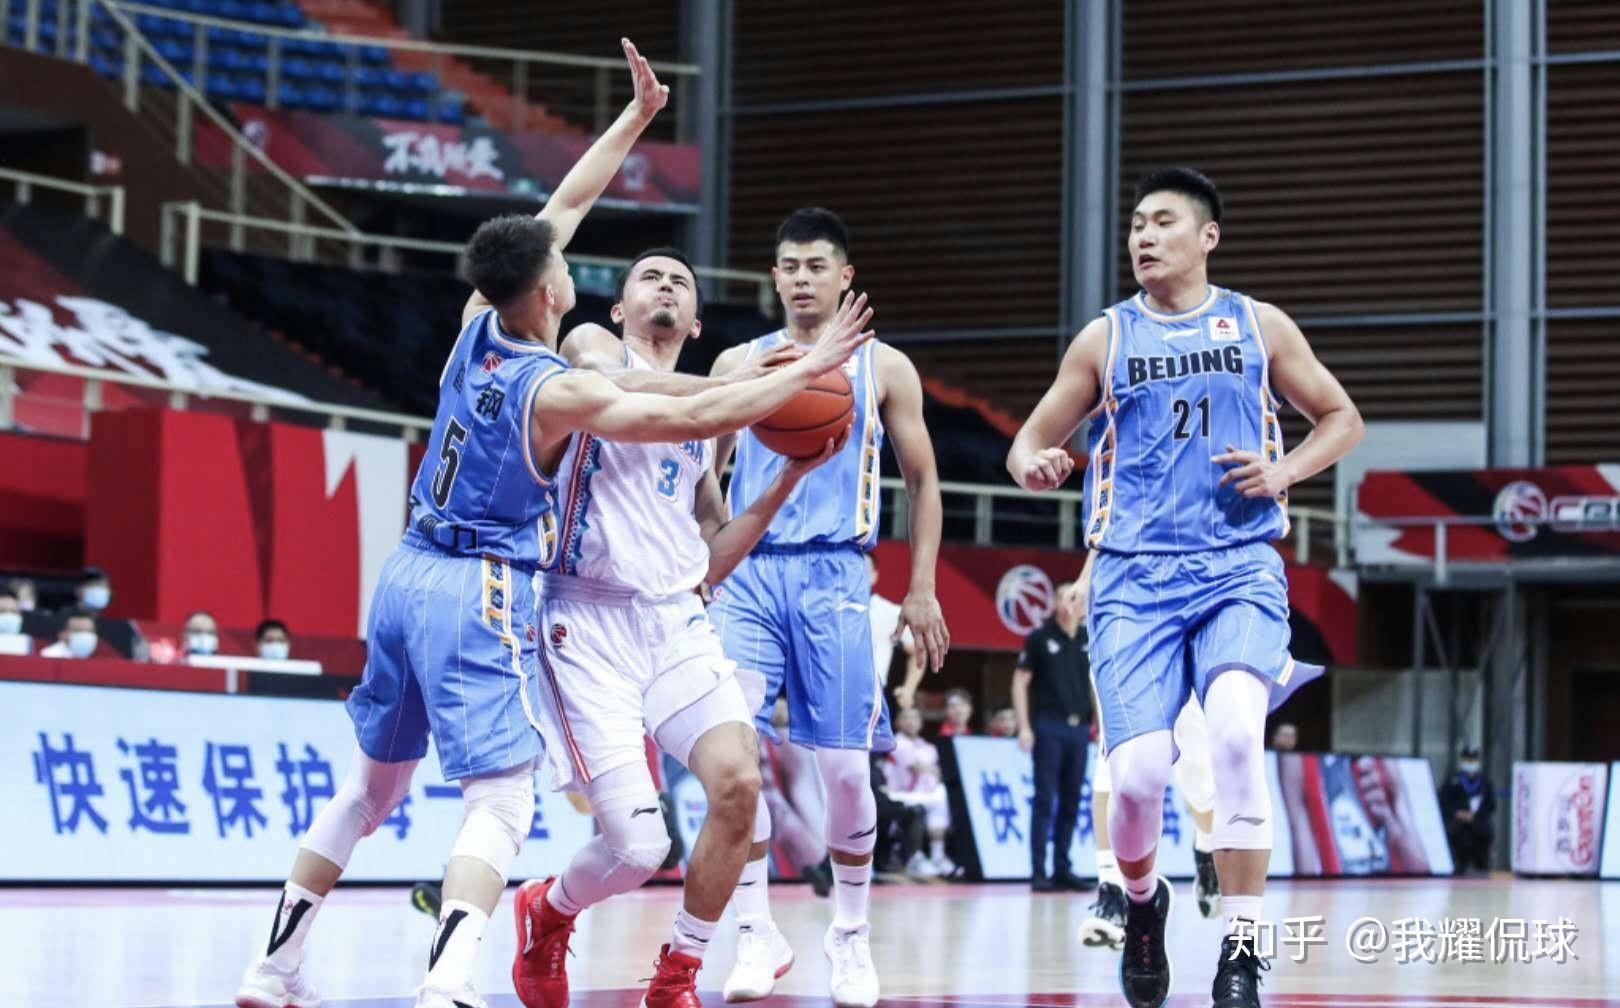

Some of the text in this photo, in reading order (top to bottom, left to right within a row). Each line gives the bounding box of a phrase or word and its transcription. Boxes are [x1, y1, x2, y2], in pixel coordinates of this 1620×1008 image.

[1127, 345, 1243, 387] BEIJING
[1172, 396, 1210, 440] 21
[431, 417, 467, 510] 5
[655, 457, 682, 501] 3
